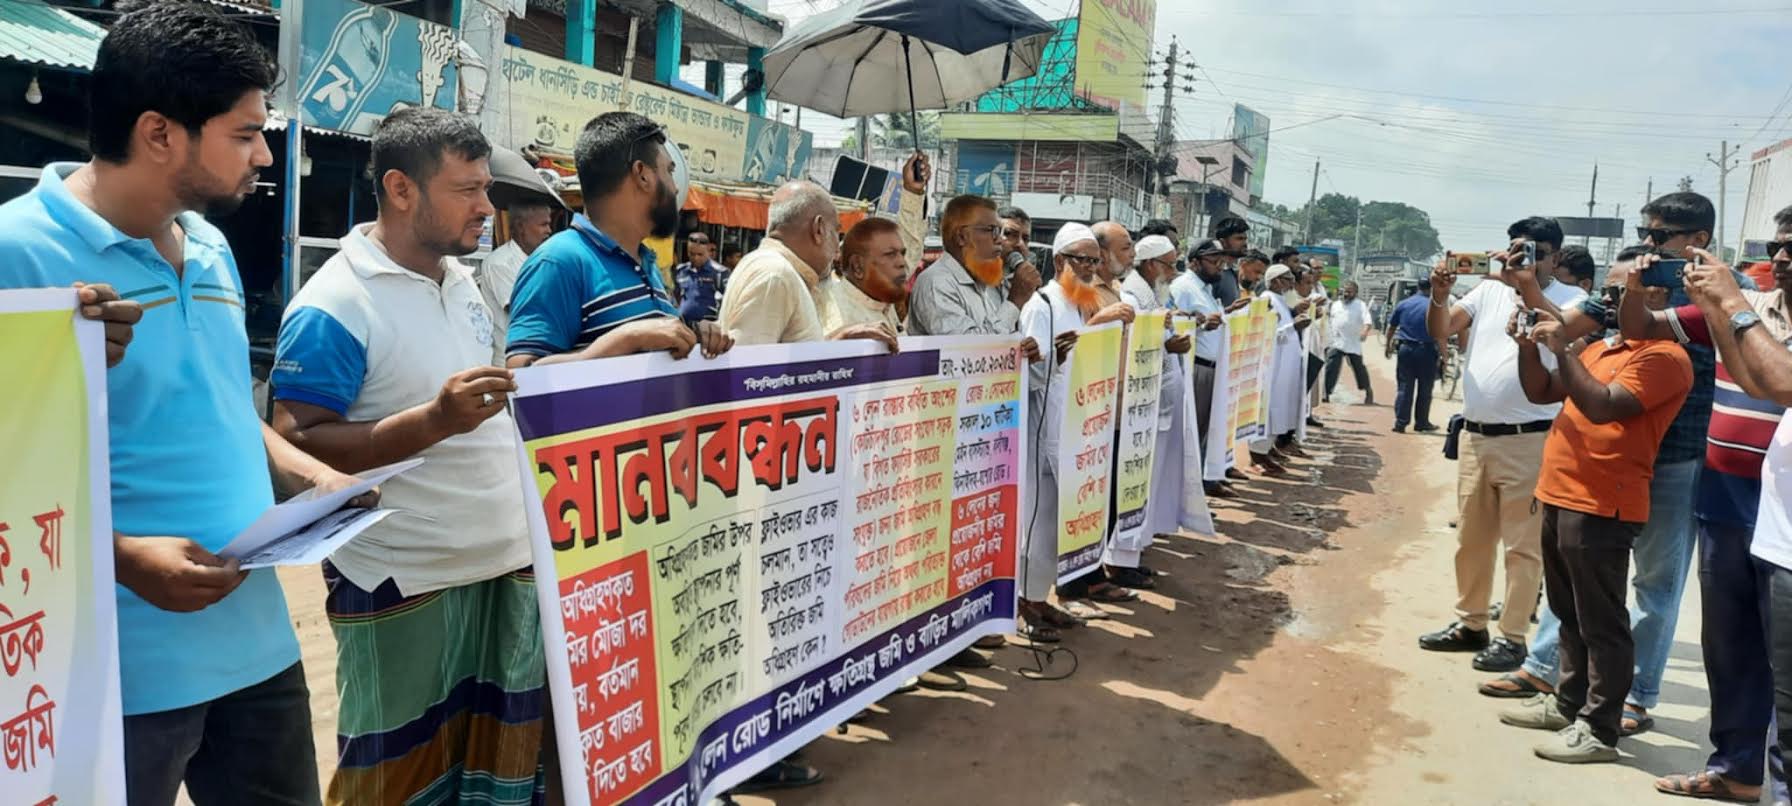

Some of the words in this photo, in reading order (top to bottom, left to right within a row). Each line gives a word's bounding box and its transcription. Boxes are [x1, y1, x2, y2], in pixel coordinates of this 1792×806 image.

[981, 413, 992, 430] ১০
[535, 395, 839, 550] মানববন্ধন
[32, 501, 65, 572] যা
[729, 522, 753, 547] উপর
[592, 617, 626, 660] মৌজা
[629, 609, 648, 640] দর
[598, 656, 639, 702] বর্তমান
[733, 708, 772, 749] রোড
[776, 679, 825, 731] নির্মাণে
[878, 633, 902, 669] জমি
[905, 632, 916, 653] ও
[918, 613, 948, 646] বাড়ির
[950, 591, 995, 629] মালিকগণ
[1, 684, 56, 773] জমি
[608, 700, 643, 743] বাজার
[593, 756, 627, 800] দিতে
[630, 739, 653, 775] হবে
